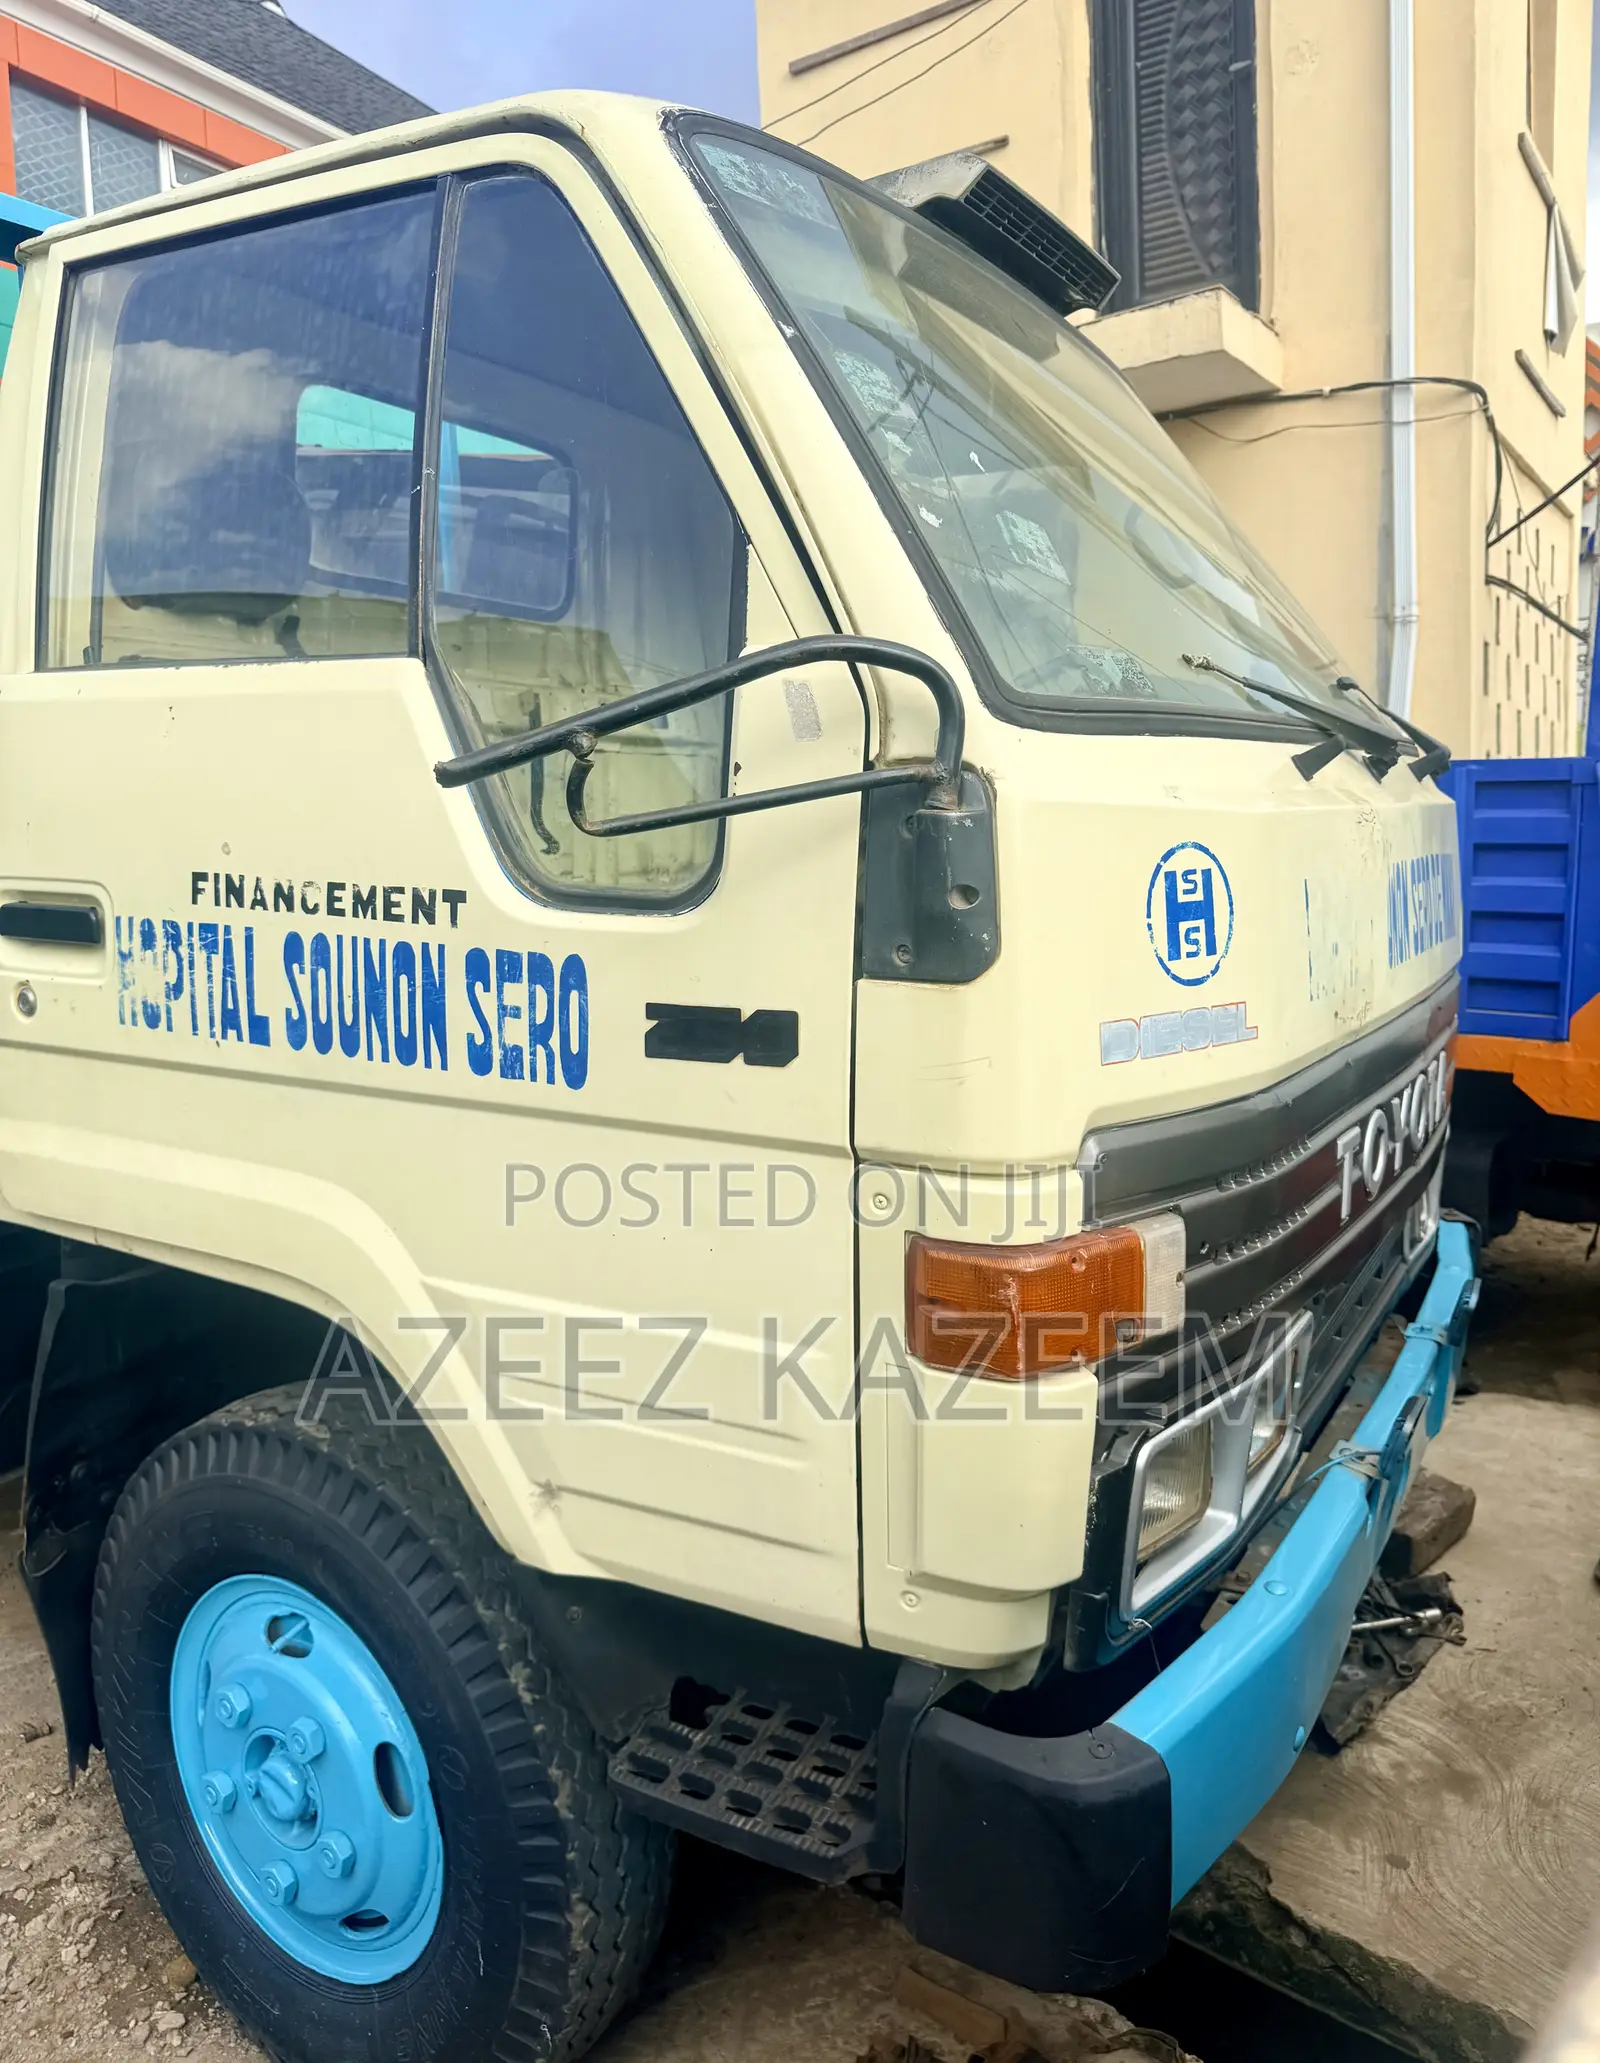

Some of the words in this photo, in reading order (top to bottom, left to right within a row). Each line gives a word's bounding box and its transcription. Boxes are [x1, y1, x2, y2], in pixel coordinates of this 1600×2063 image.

[191, 871, 467, 929] FINANCEMENT
[115, 915, 271, 1048] HOPITAL
[283, 930, 448, 1072] SOUNON
[465, 946, 589, 1091] SERO
[1099, 1000, 1258, 1067] DIESEL
